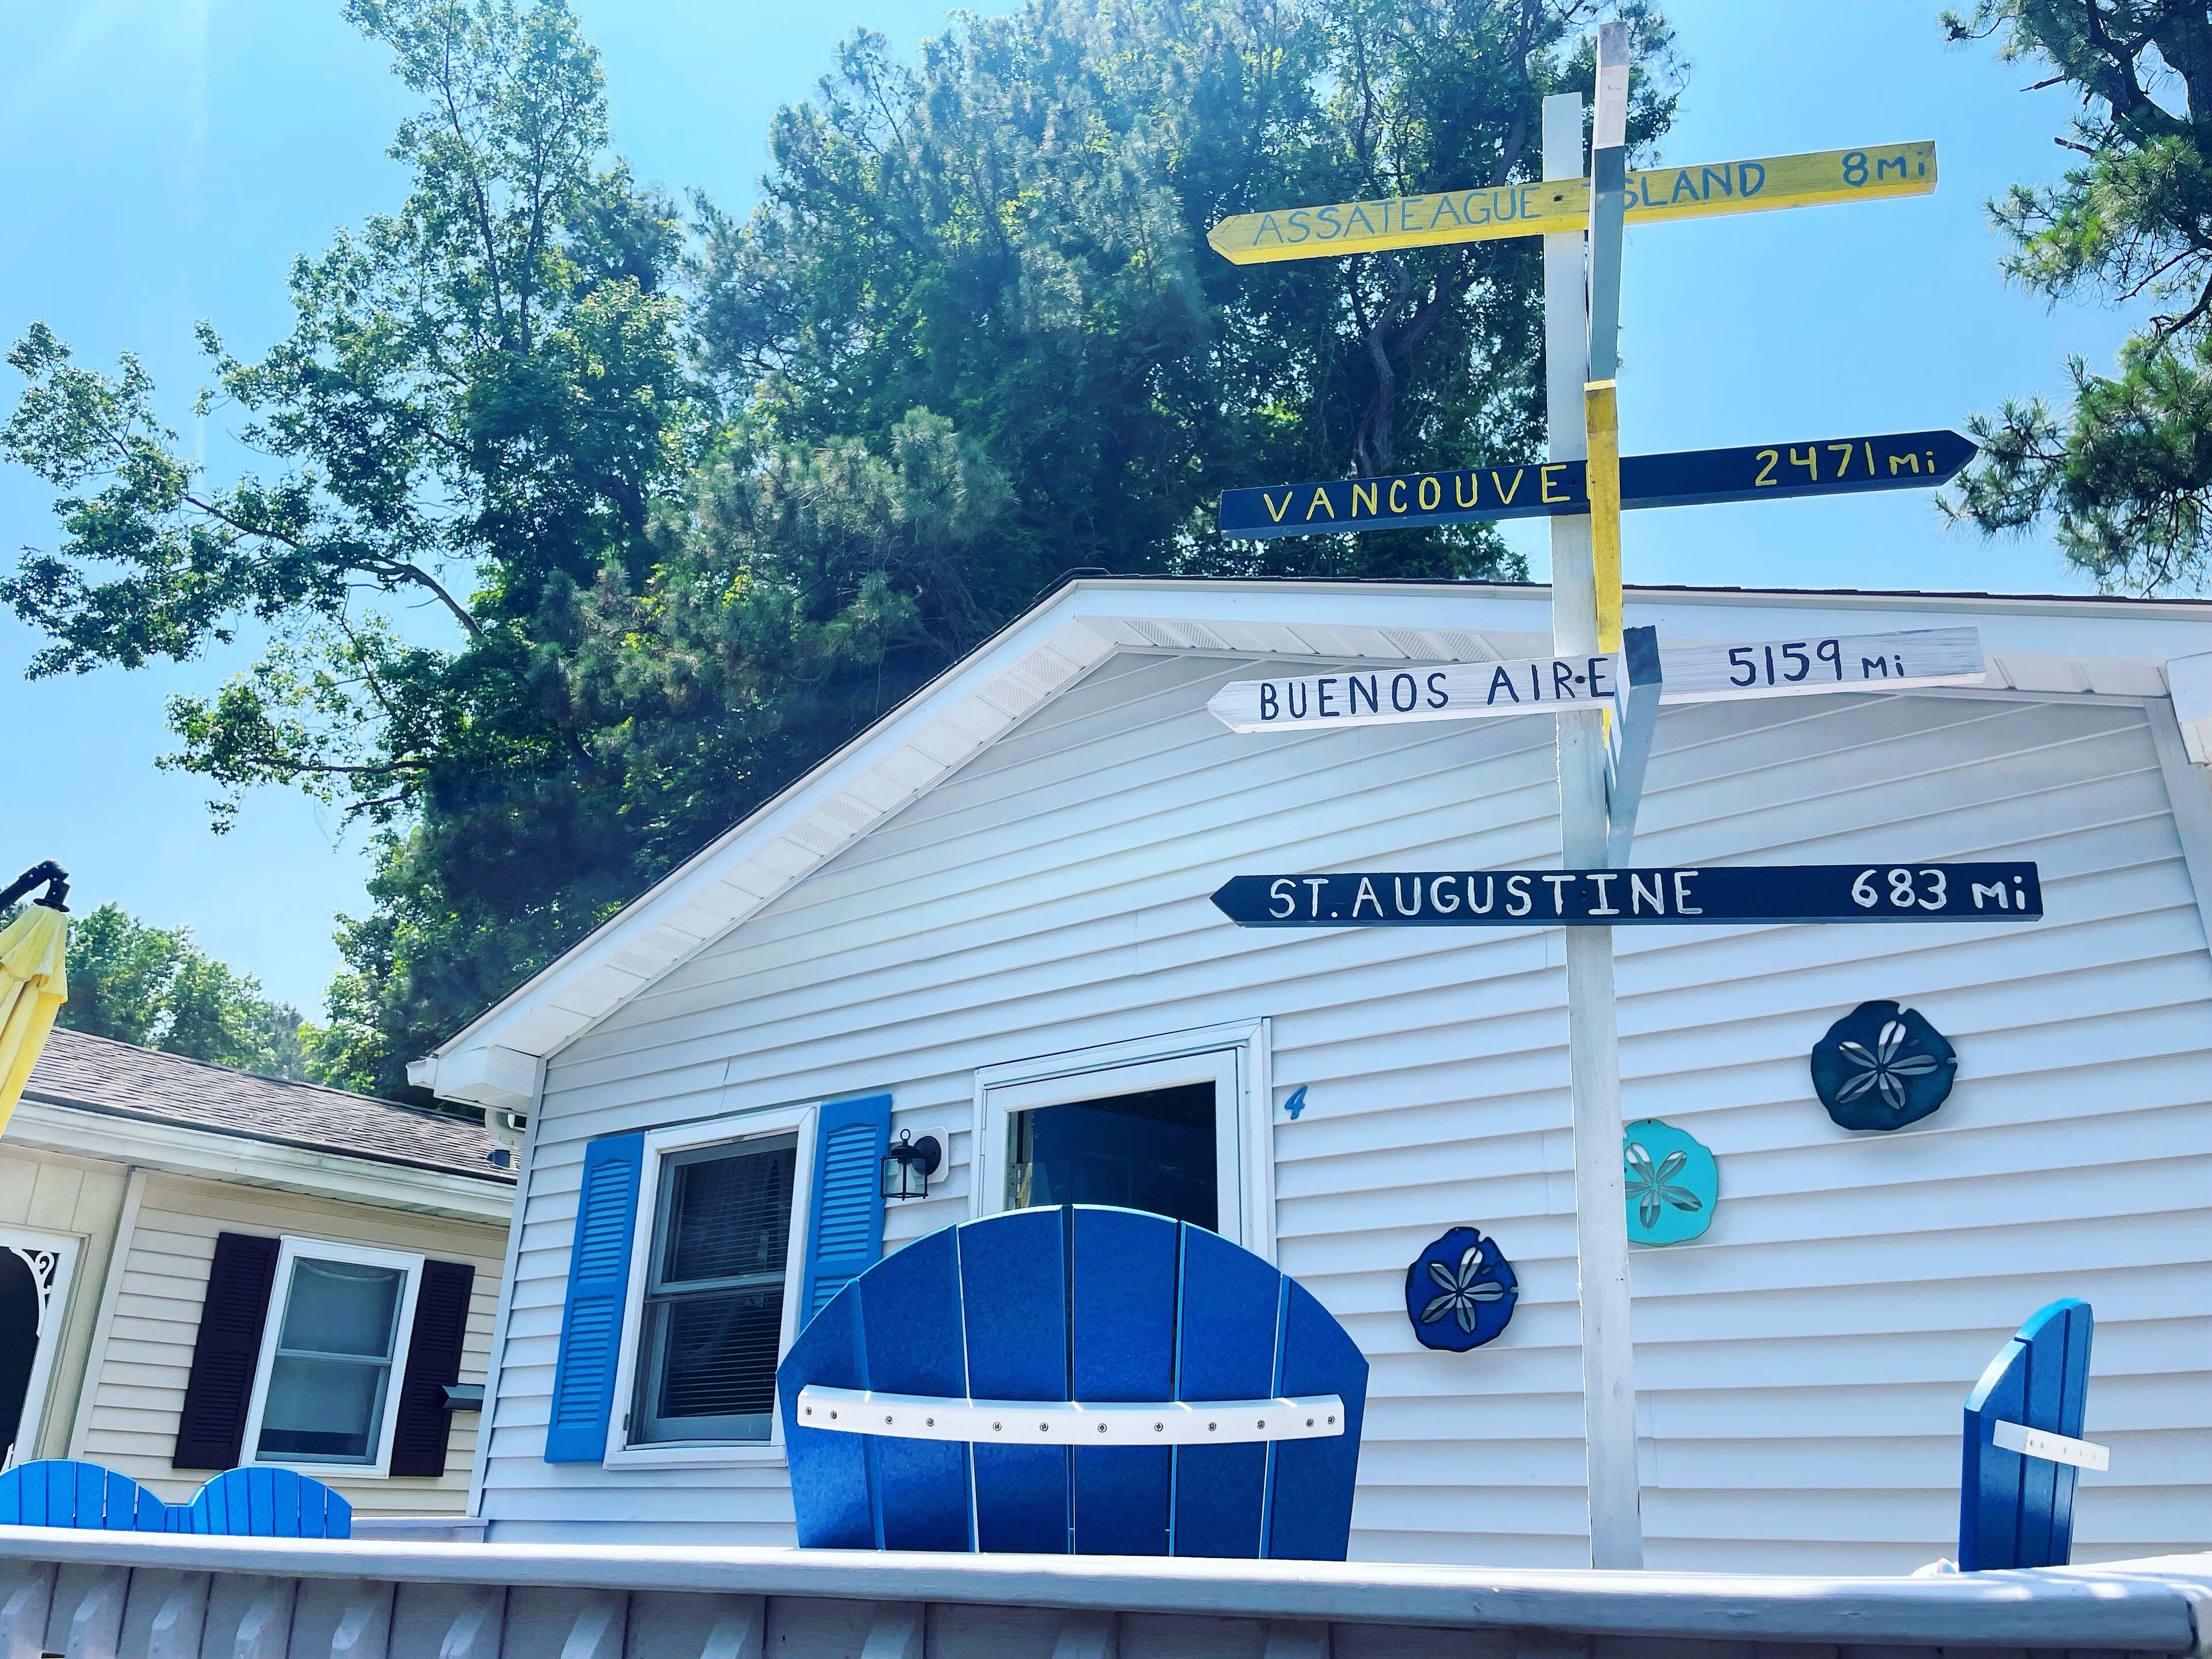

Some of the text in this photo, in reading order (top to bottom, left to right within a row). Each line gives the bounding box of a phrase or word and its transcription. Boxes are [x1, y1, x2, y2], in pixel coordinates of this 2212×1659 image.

[1253, 187, 1542, 245] ASSATEAGUE
[1580, 163, 1765, 212] SLAND
[1842, 151, 1869, 187] 8
[1263, 463, 1590, 522] VANCOUVE
[1755, 442, 1874, 487] 2471
[1260, 672, 1449, 721] BUENOS
[1729, 639, 1842, 686] 5159
[1351, 870, 1703, 916] AUGUSTINE
[1851, 869, 1947, 910] 683
[1284, 1085, 1308, 1120] 4
